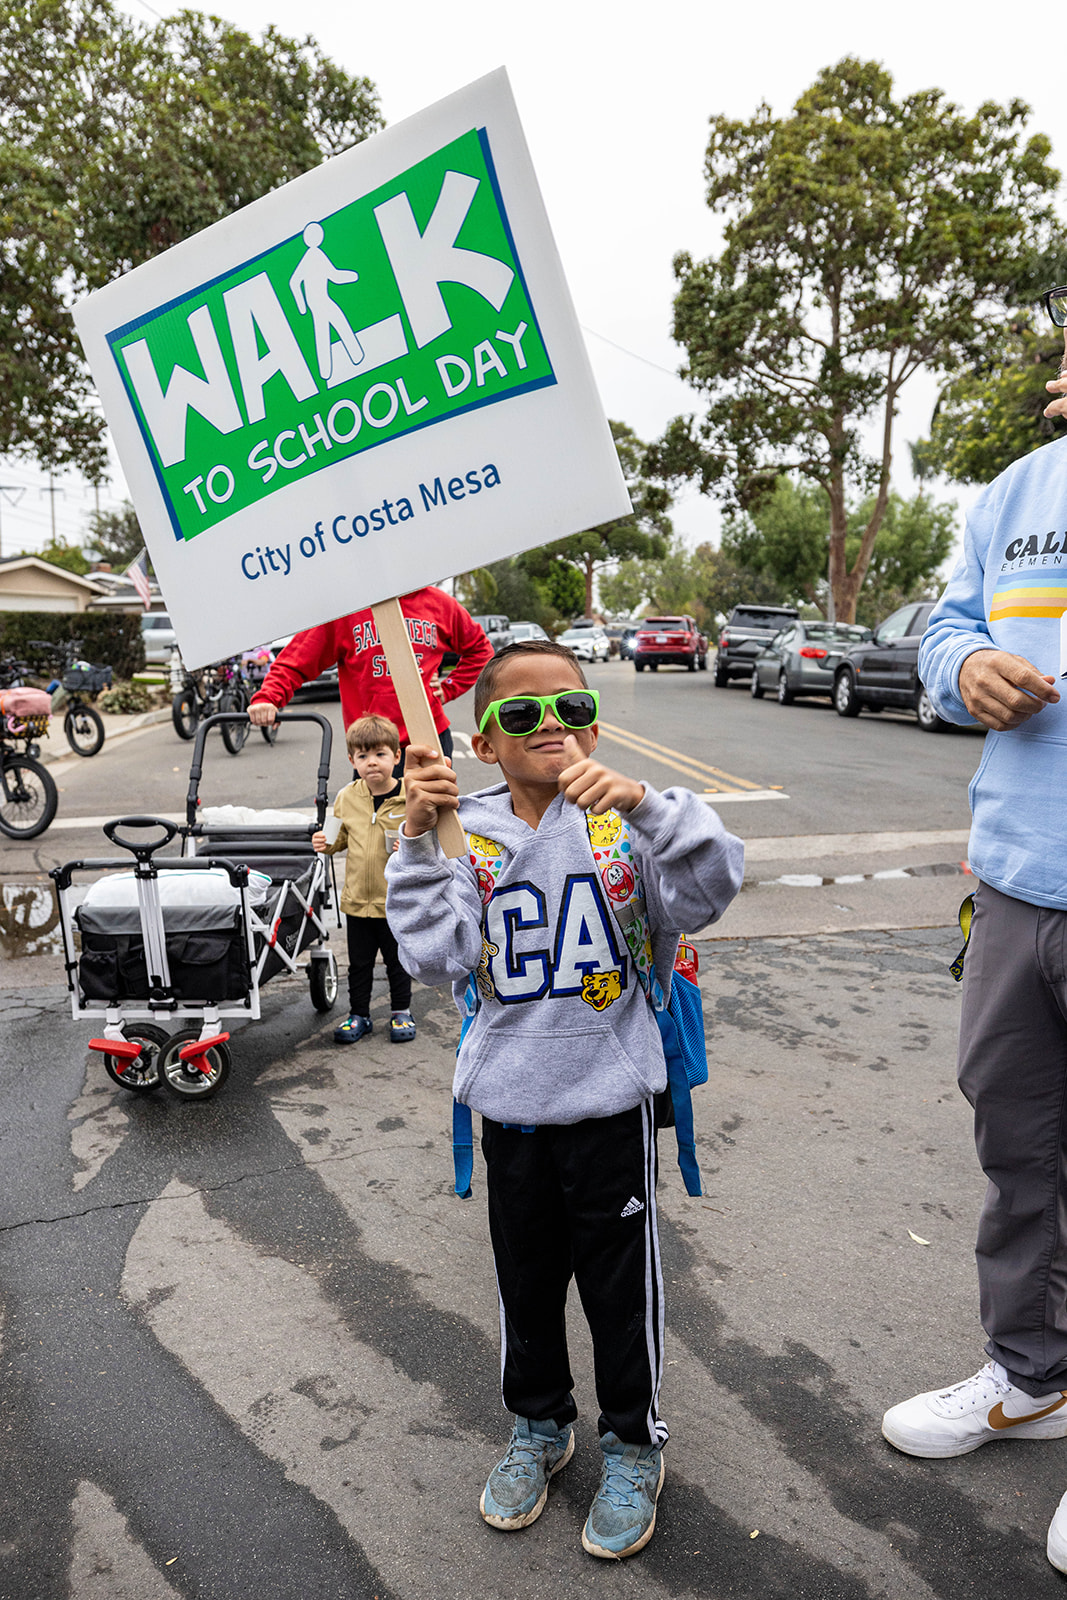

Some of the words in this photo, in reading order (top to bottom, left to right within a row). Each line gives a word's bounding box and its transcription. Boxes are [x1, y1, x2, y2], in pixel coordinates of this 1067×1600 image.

[120, 170, 515, 468] WALK
[183, 464, 235, 515] TO
[247, 376, 429, 484] SCHOOL
[435, 320, 529, 399] DAY
[240, 535, 292, 581] City
[298, 522, 326, 559] of
[332, 493, 415, 545] Costa
[418, 463, 502, 511] Mesa
